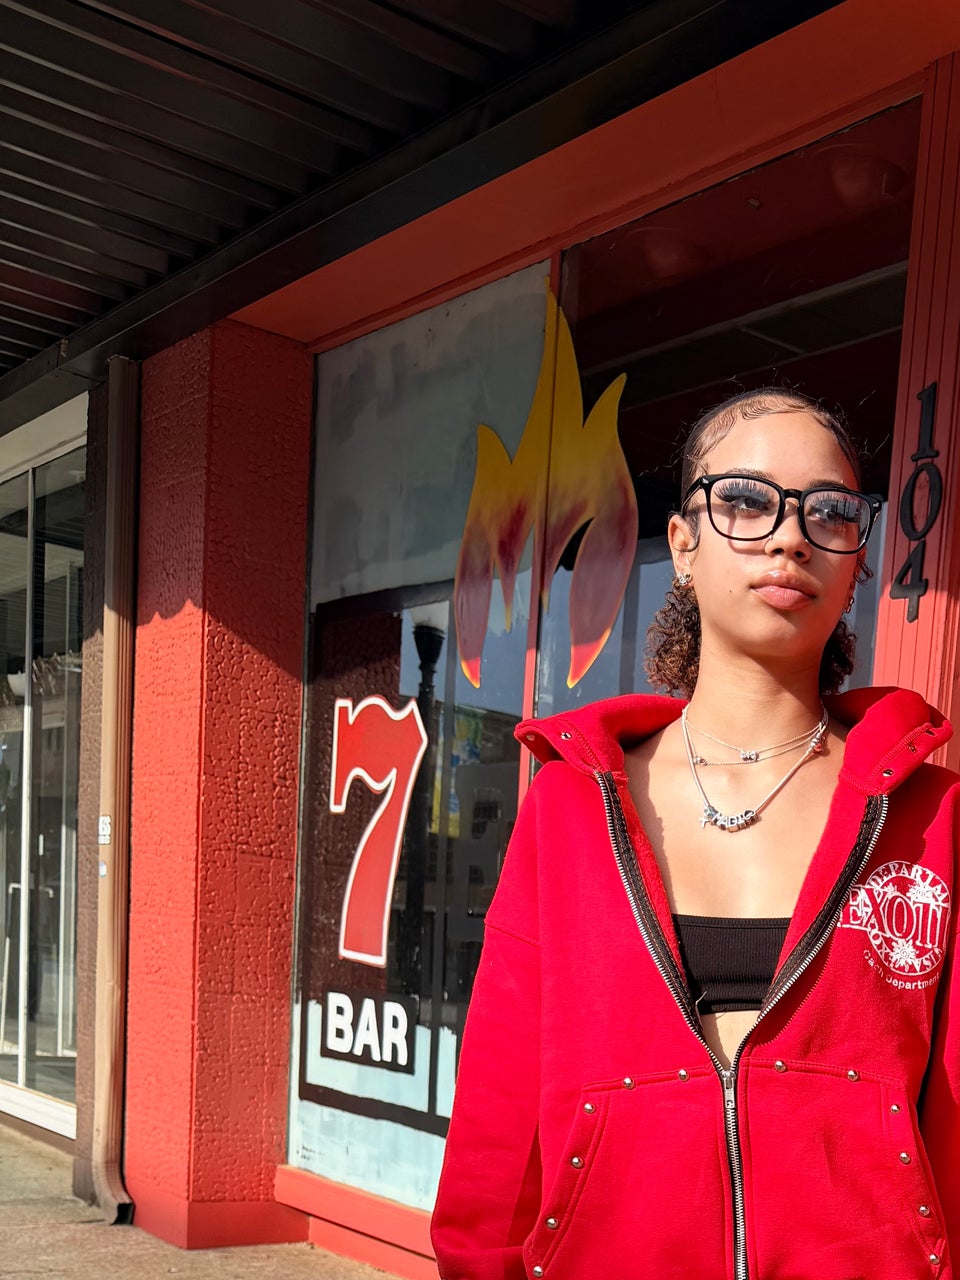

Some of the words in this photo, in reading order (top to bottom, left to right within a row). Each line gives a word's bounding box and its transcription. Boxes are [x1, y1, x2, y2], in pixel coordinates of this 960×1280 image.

[889, 381, 943, 623] 104
[330, 697, 427, 967] 7
[327, 992, 408, 1065] BAR
